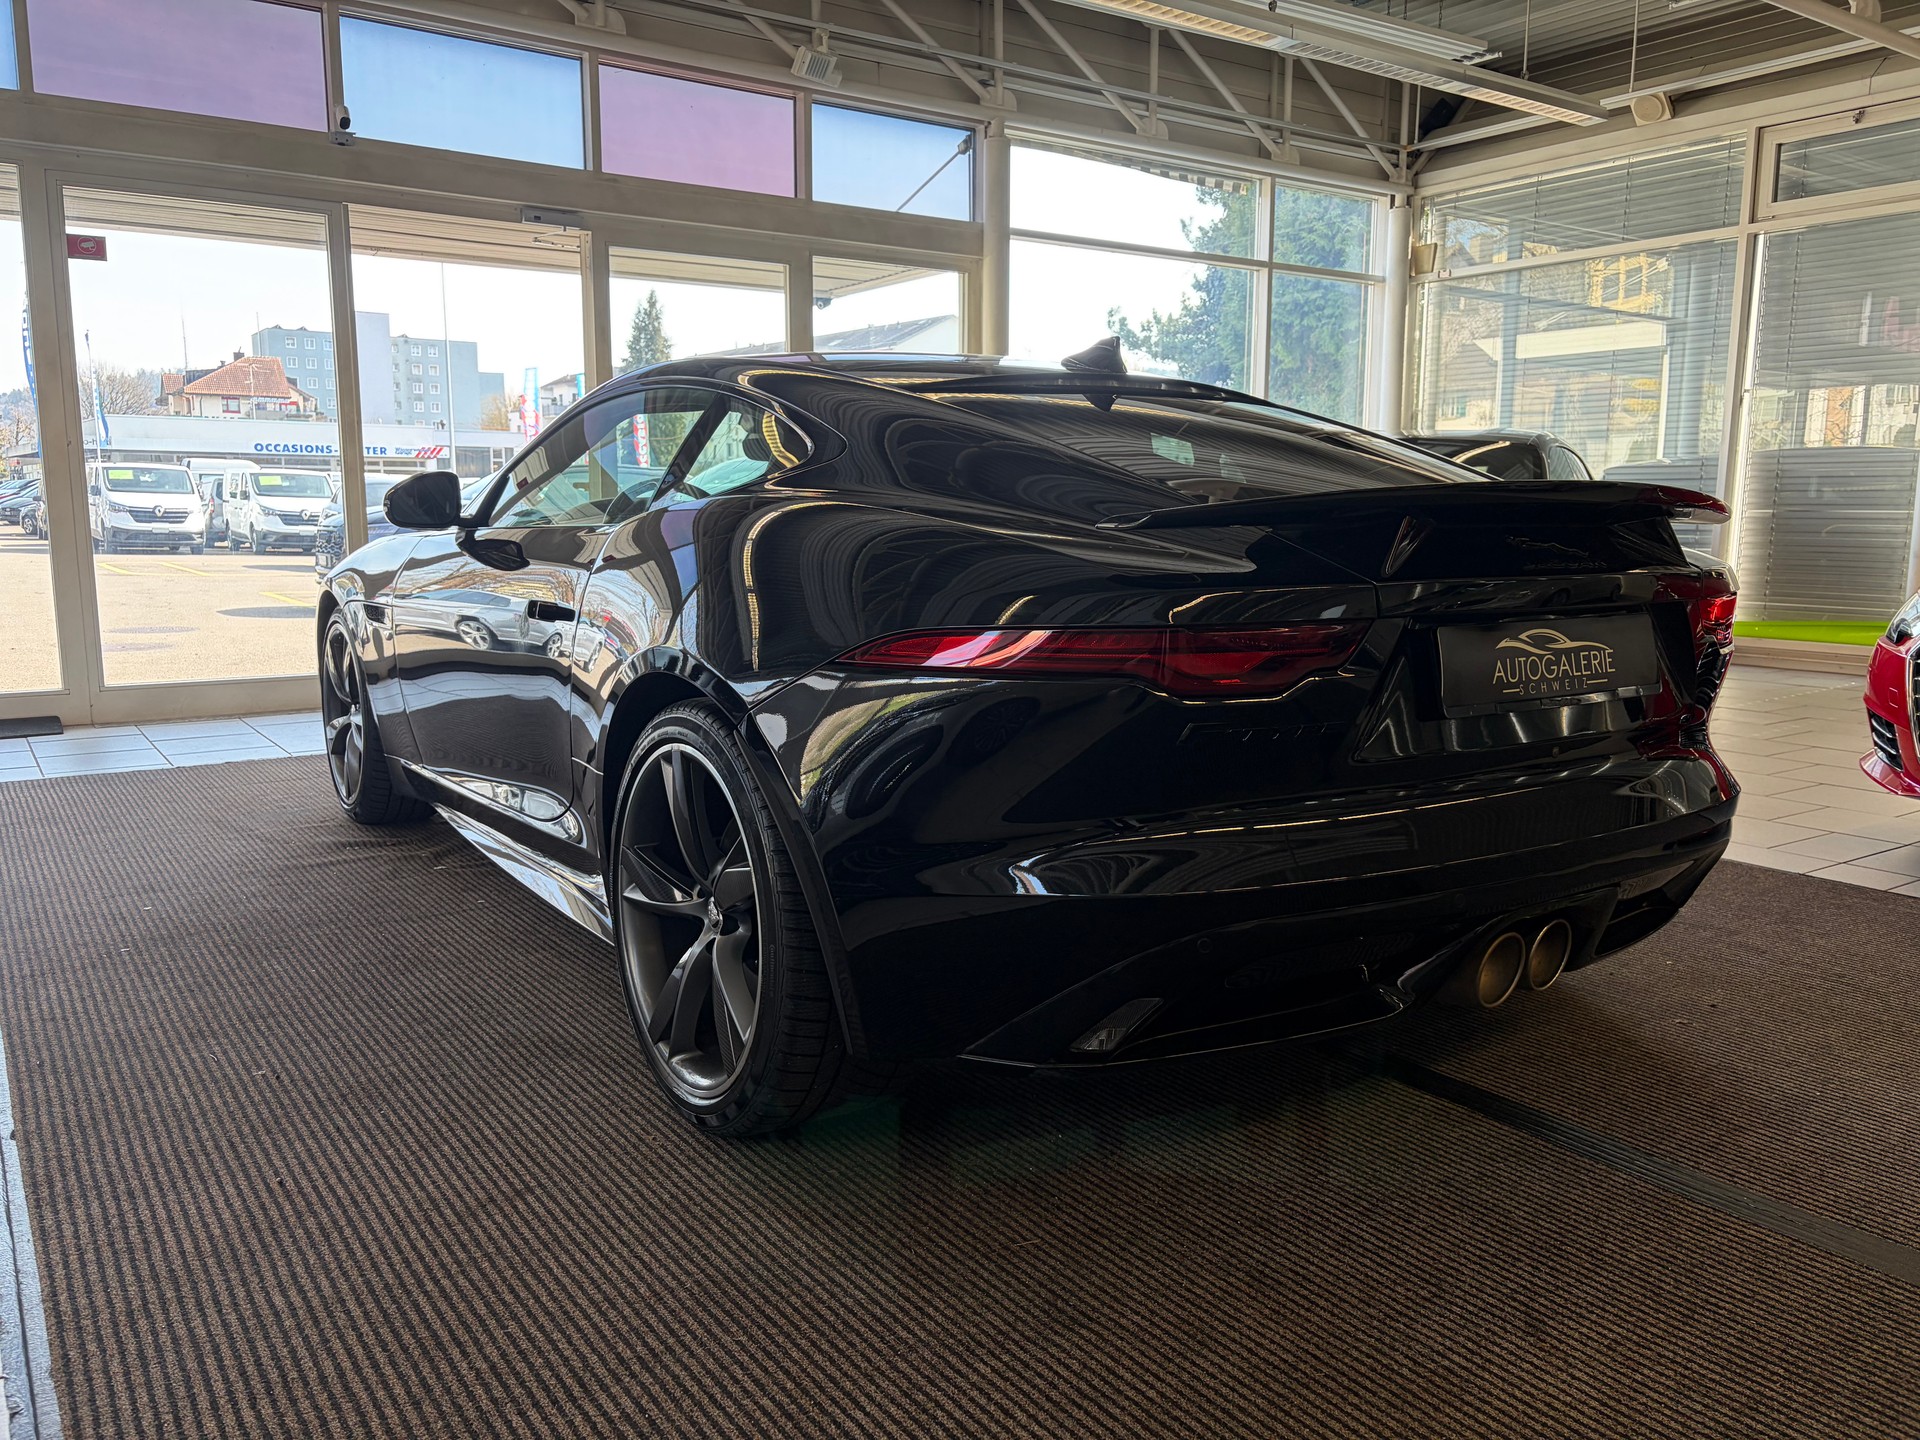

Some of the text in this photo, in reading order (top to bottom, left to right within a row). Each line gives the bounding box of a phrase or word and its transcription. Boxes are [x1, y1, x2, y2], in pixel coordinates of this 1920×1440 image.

[254, 443, 387, 455] OCCASIONS-TER
[1492, 650, 1616, 685] AUTOGALERIE
[1518, 677, 1588, 696] SCHWEIZ
